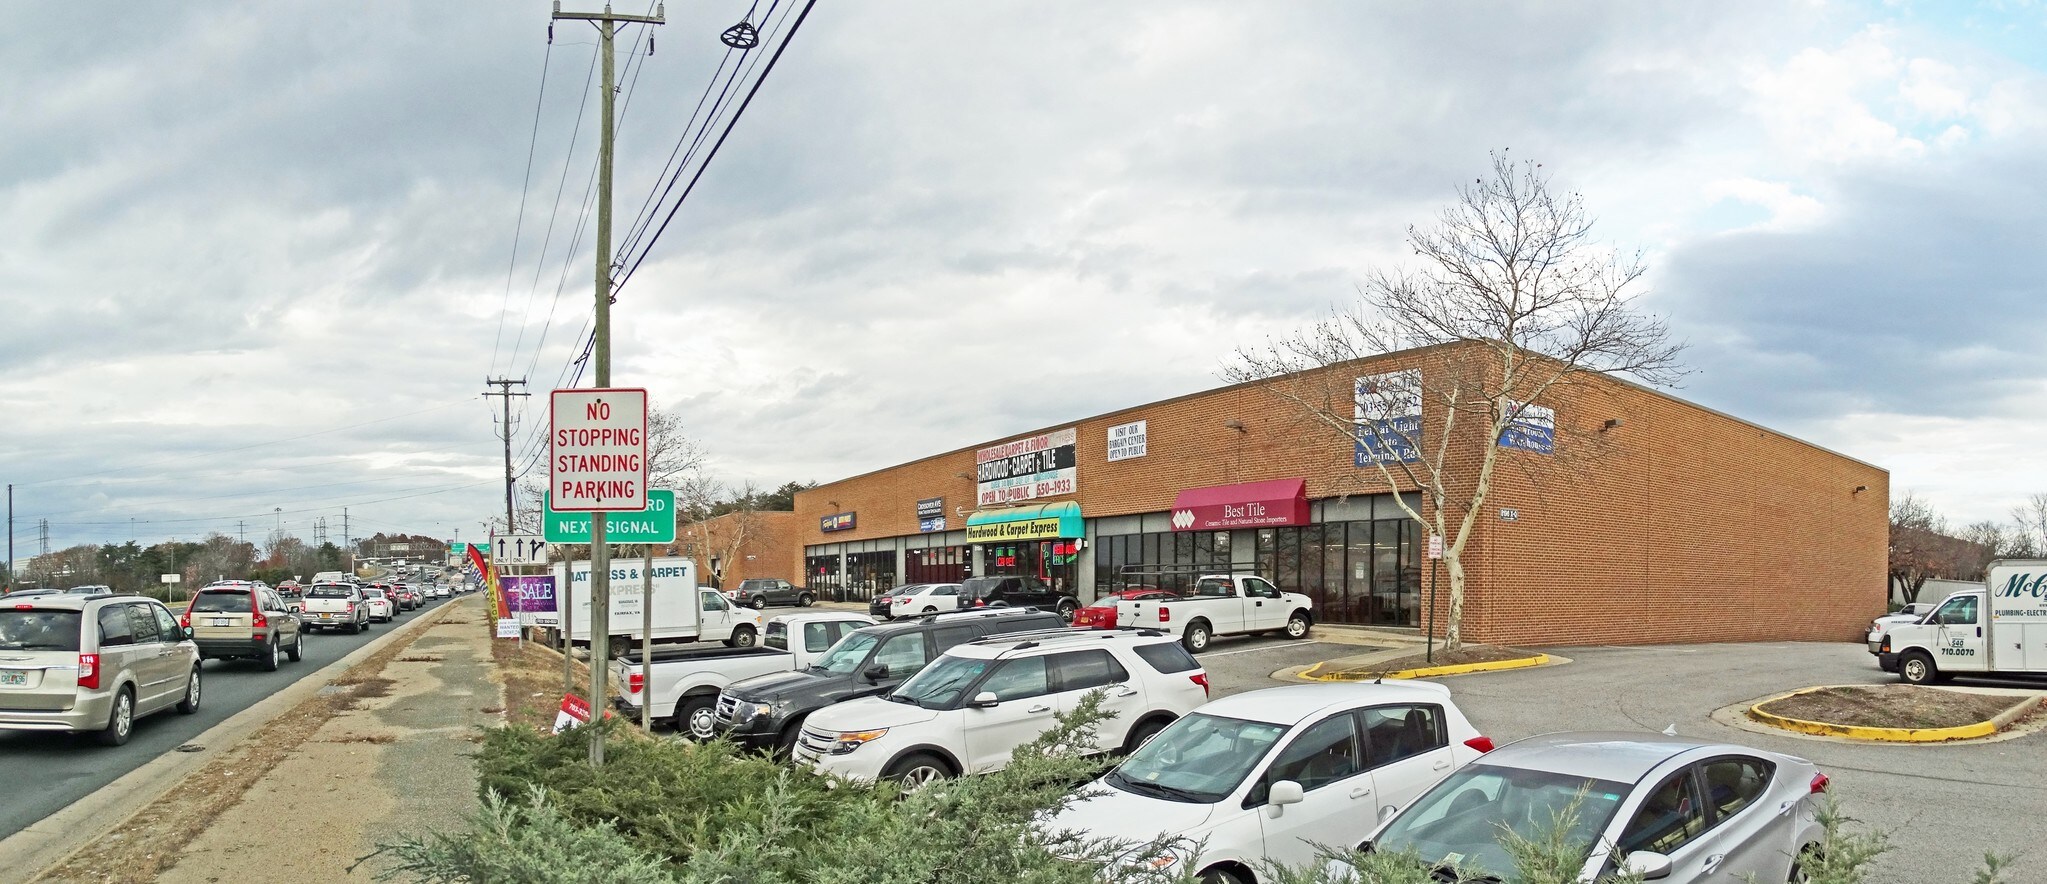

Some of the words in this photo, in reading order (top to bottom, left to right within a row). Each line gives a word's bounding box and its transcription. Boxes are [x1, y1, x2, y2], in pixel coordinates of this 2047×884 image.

[587, 403, 610, 420] NO
[558, 429, 640, 446] STOPPING
[1115, 427, 1126, 437] VISIT
[1128, 424, 1138, 434] OUR
[1030, 436, 1049, 452] FLOOR
[1128, 434, 1146, 446] CENTER
[1128, 445, 1144, 456] PUBLIC
[558, 455, 639, 472] STANDING
[978, 458, 1008, 482] HARDWOOD
[1012, 454, 1036, 476] CARPET
[1042, 449, 1056, 470] TILE
[562, 481, 634, 498] PARKING
[982, 491, 996, 503] OPEN
[998, 489, 1006, 501] TO
[1008, 486, 1030, 500] PUBLIC
[1224, 504, 1244, 518] Best
[1247, 502, 1266, 516] Tile
[560, 521, 592, 533] NEX
[606, 521, 658, 533] SIGNAL
[1266, 516, 1287, 525] Importers
[968, 524, 998, 538] Hardwood
[1000, 524, 1005, 536] &
[1006, 523, 1028, 538] Carpet
[1030, 522, 1058, 536] Express
[630, 568, 638, 579] &
[521, 583, 552, 600] SALE
[1942, 648, 1974, 656] 710.0070
